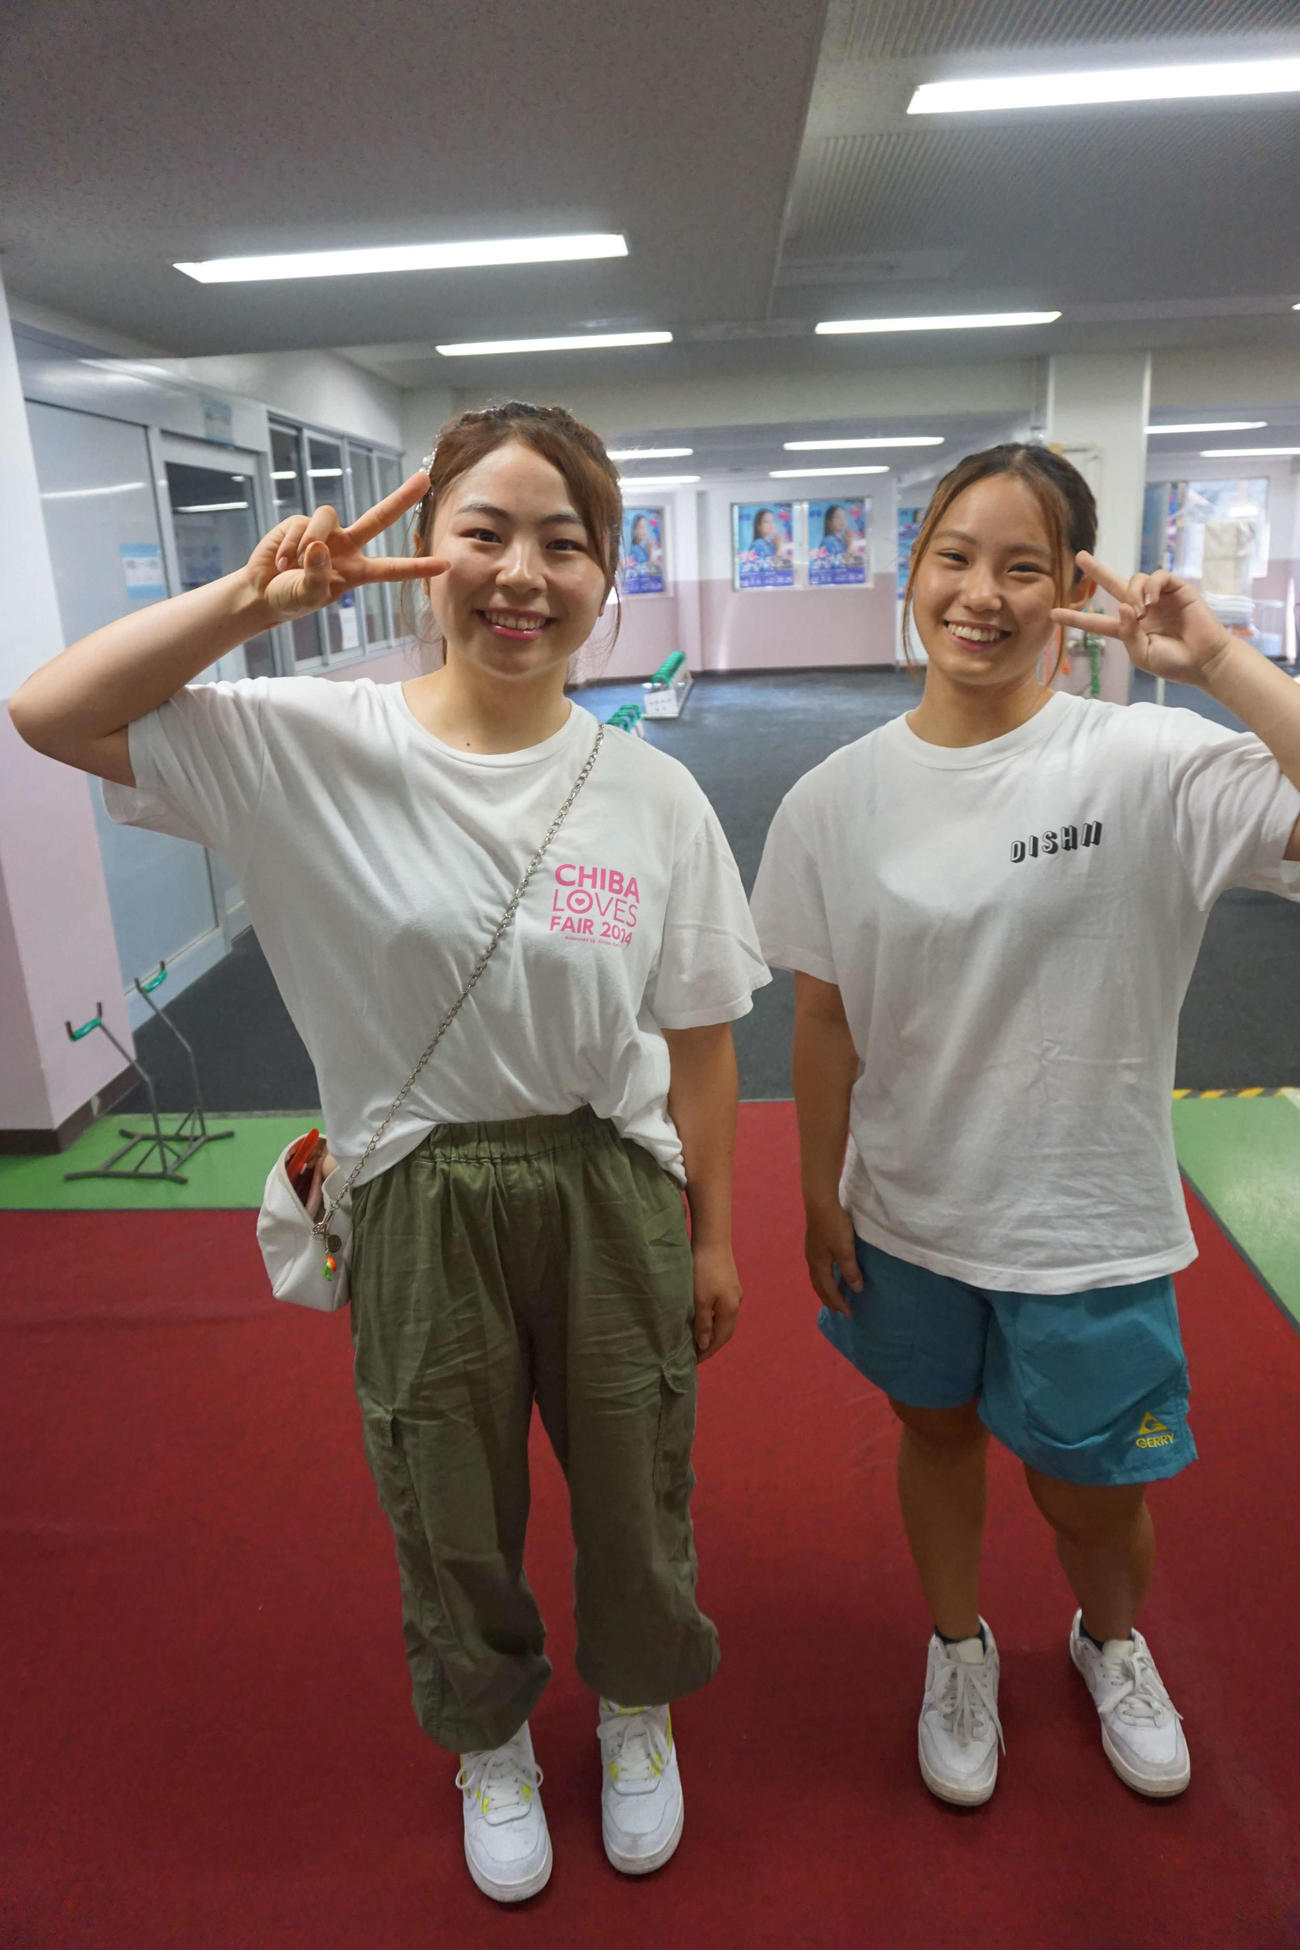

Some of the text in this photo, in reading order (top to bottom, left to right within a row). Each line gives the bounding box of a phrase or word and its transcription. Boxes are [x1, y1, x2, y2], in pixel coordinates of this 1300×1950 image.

[555, 864, 639, 904] CHIBA
[552, 888, 638, 927] LOVES
[549, 915, 594, 935] FAIR
[600, 921, 632, 946] 2014
[1136, 1432, 1175, 1449] GERRY
